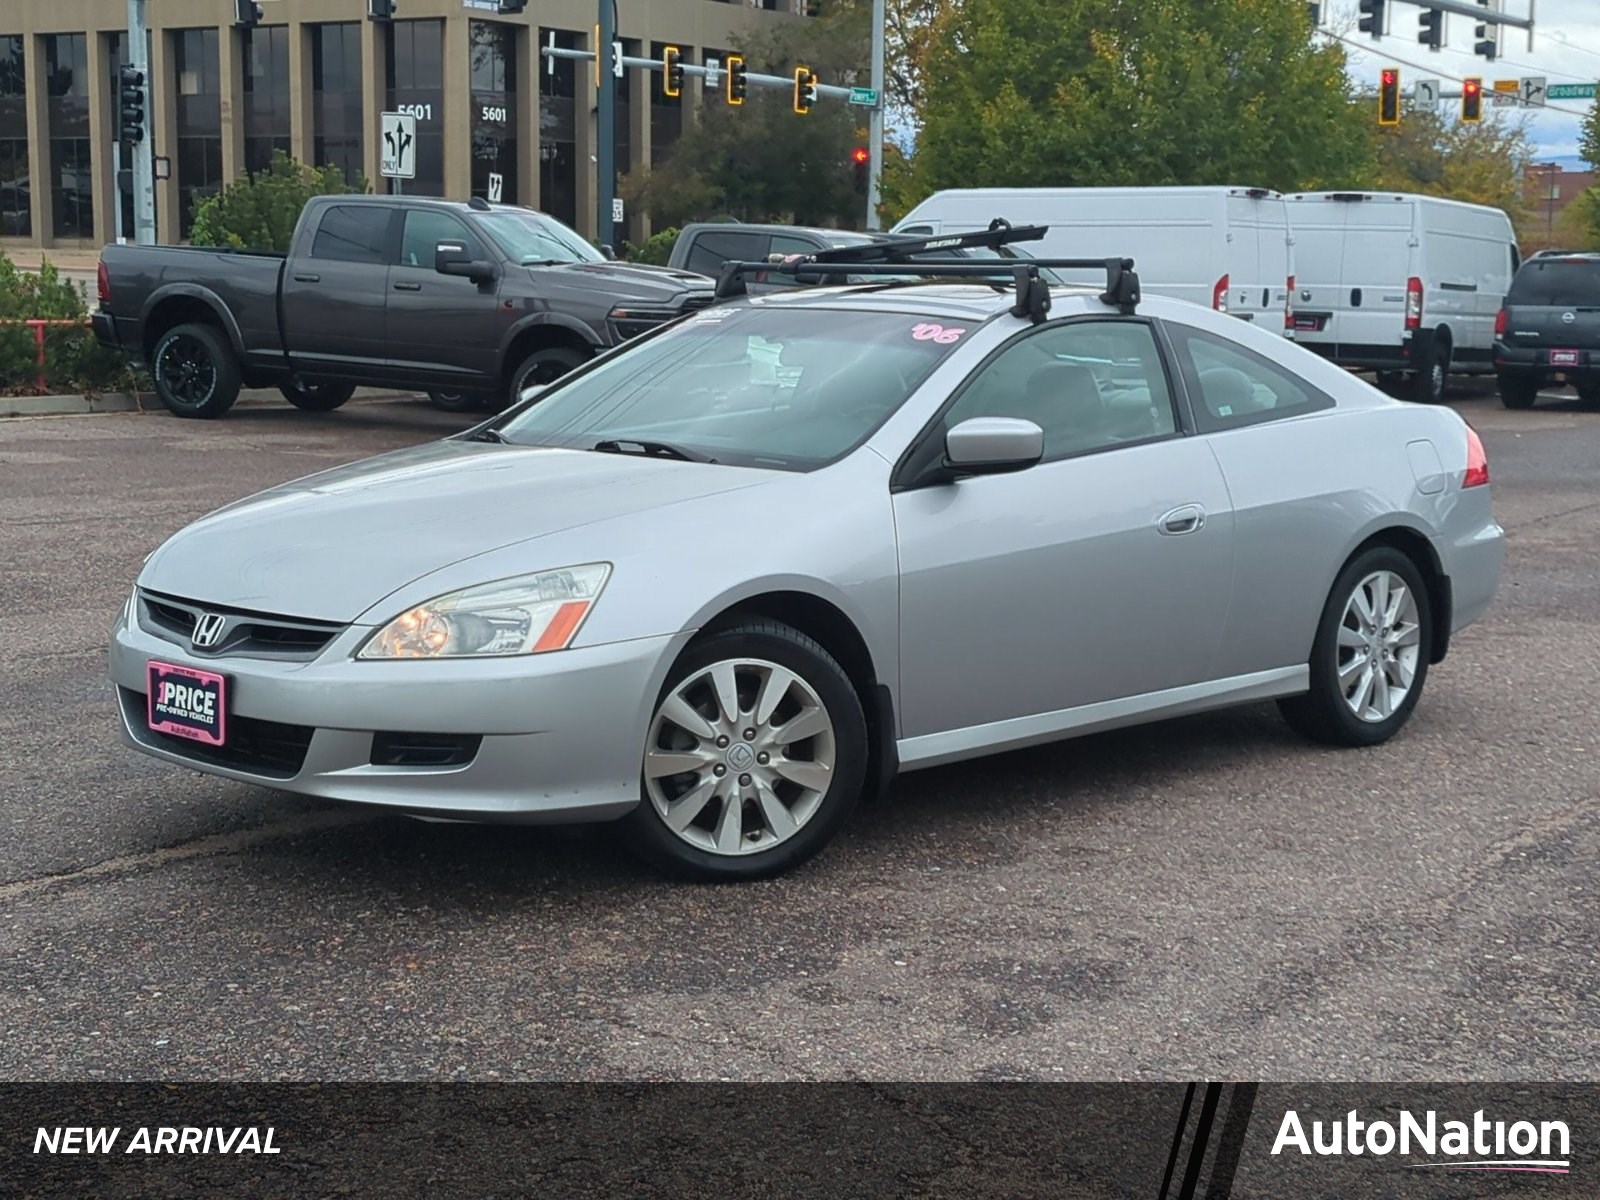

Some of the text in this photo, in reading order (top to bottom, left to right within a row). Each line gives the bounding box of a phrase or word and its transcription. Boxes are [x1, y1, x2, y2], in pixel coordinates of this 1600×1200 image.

[1549, 86, 1595, 98] Broadway
[482, 106, 507, 122] 5601
[383, 160, 397, 171] ONLY
[156, 703, 214, 725] PRE-OWNED VEHICLES
